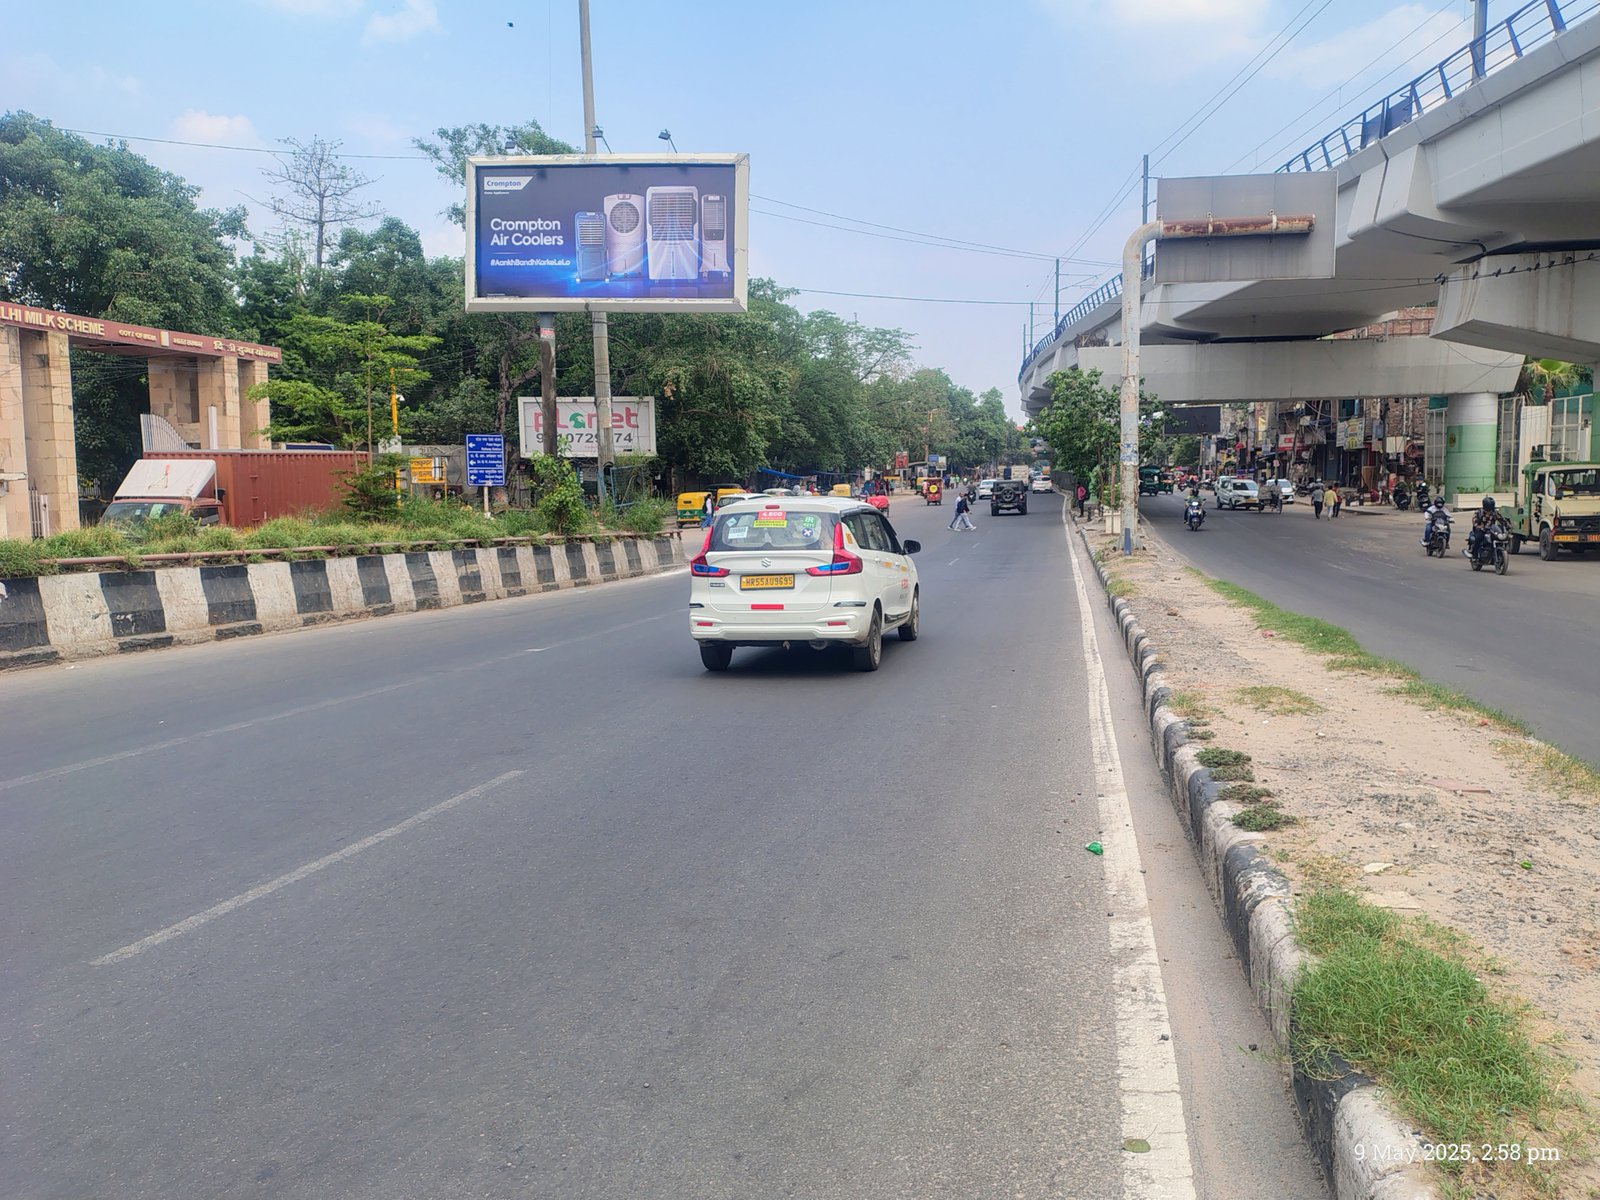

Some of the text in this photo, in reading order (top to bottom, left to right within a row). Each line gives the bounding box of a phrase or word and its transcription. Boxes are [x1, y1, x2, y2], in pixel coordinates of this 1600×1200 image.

[486, 180, 521, 188] Crompton
[490, 217, 561, 233] Crompton
[490, 233, 564, 246] Air Coolers
[0, 305, 106, 336] LHI MILK SCHEME
